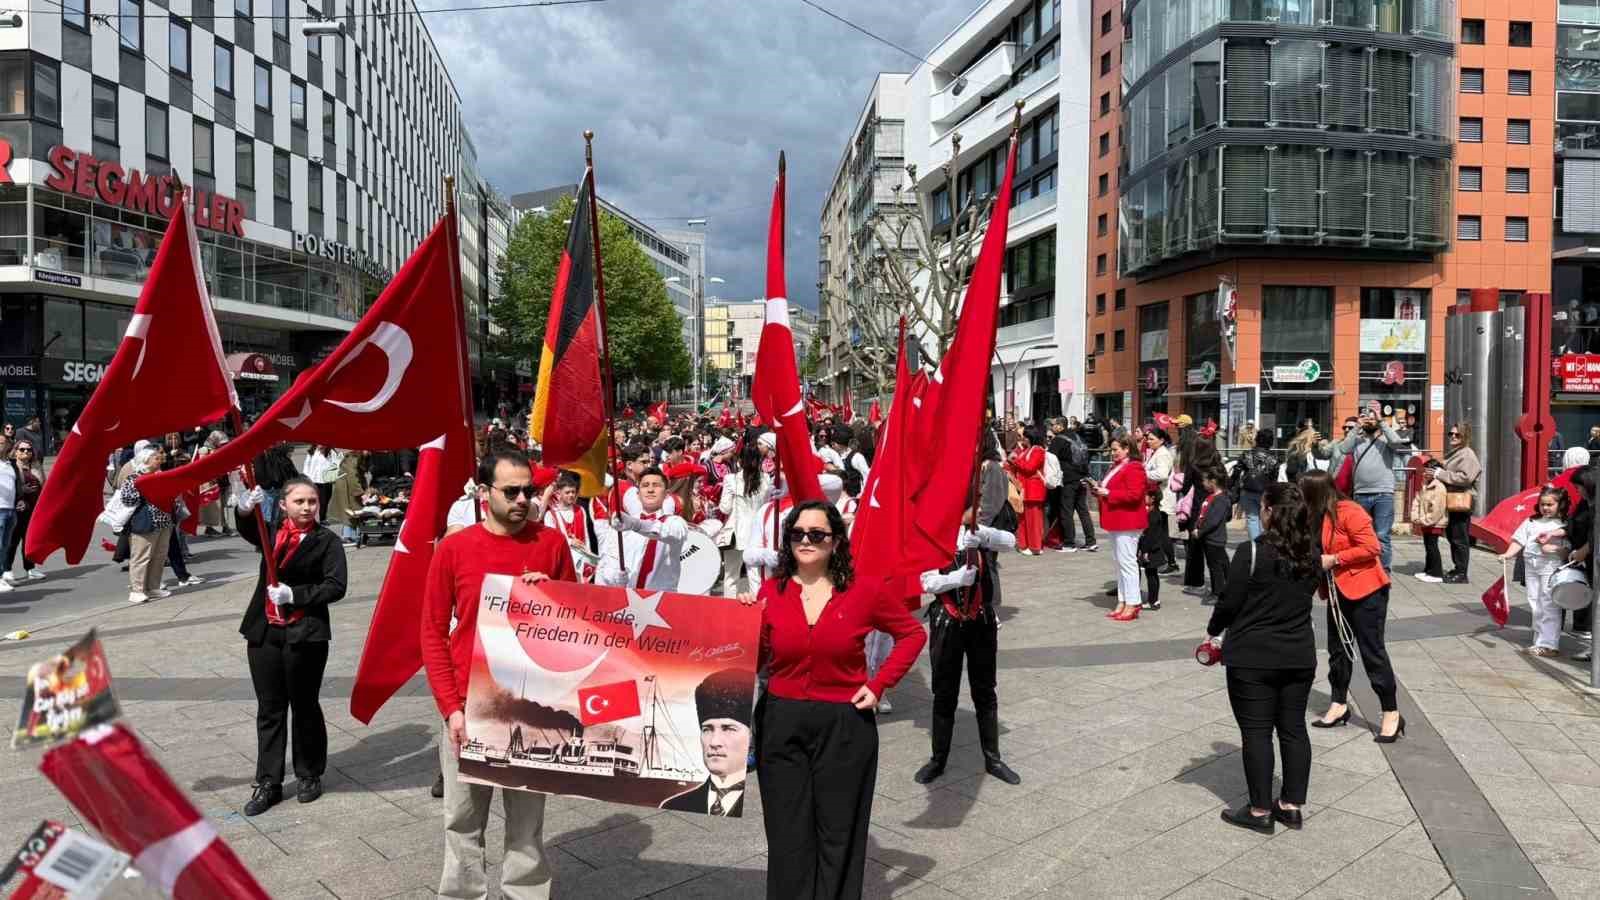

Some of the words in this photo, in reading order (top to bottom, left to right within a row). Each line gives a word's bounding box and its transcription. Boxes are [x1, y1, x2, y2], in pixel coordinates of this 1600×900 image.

[484, 595, 552, 618] "Frieden
[556, 602, 577, 620] im
[581, 604, 639, 628] Lande,
[515, 622, 579, 644] Frieden
[583, 629, 600, 646] in
[603, 631, 632, 649] der
[639, 638, 690, 655] Welt!"
